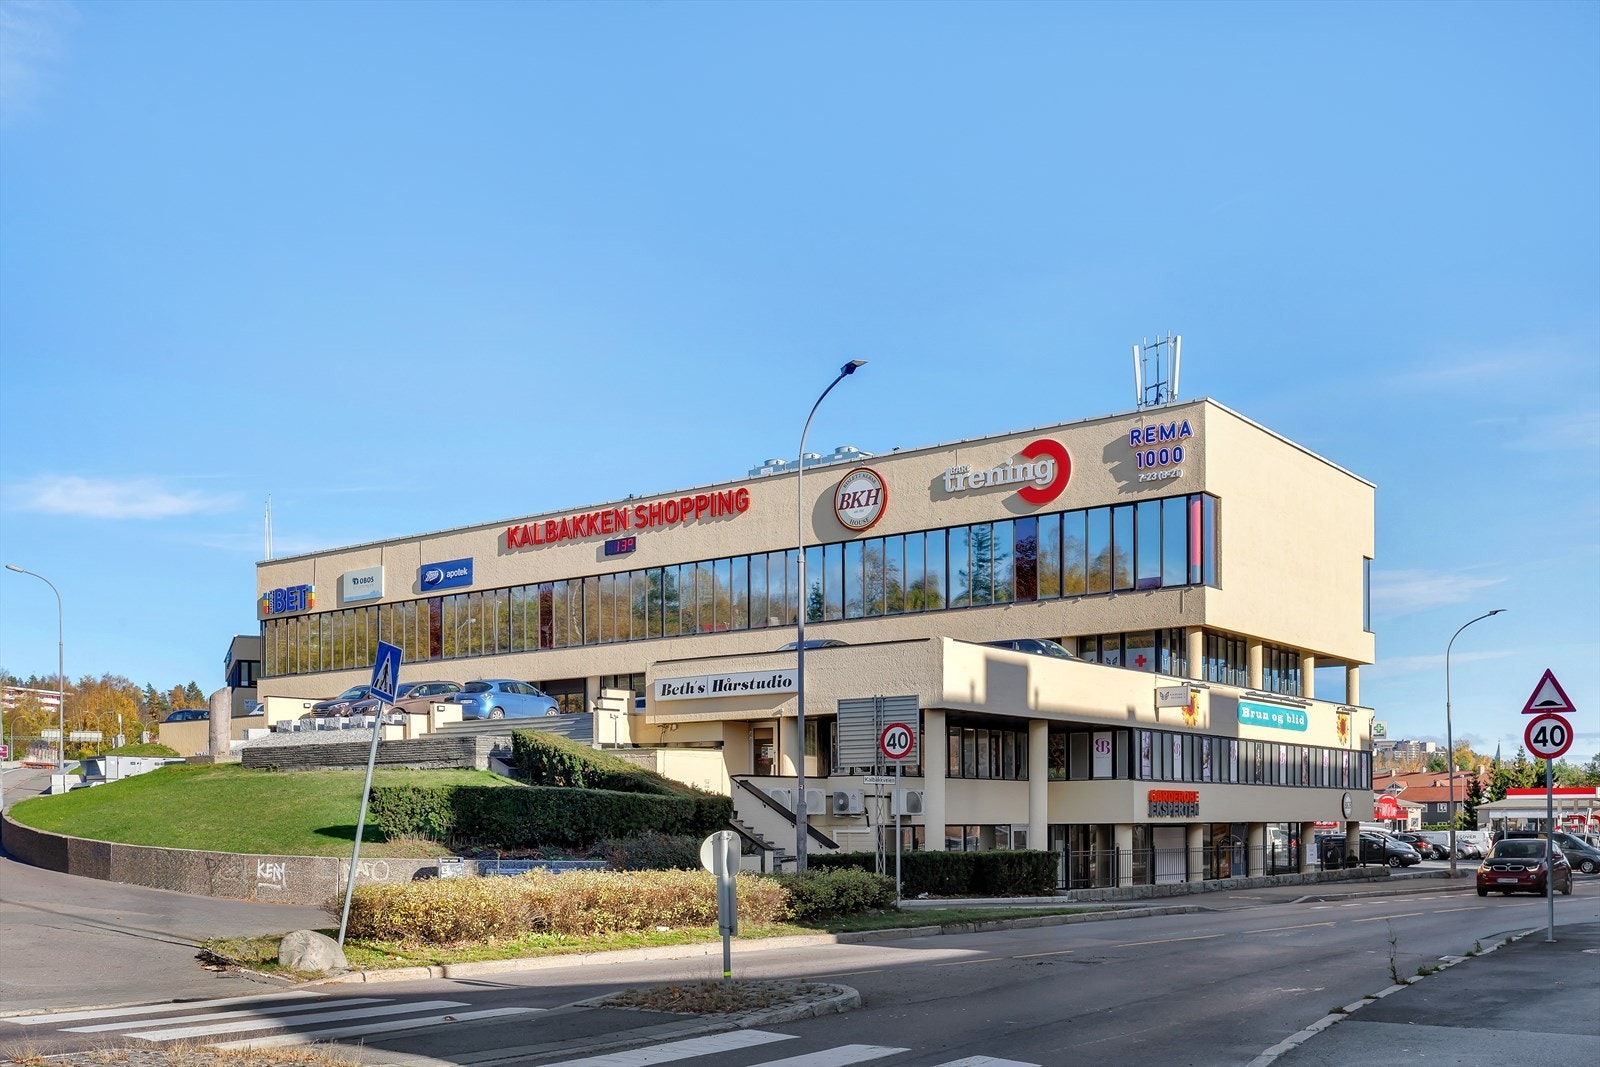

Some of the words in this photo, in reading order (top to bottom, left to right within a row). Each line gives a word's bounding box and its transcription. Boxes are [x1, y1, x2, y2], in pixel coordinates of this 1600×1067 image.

[1129, 419, 1194, 446] REMA
[1136, 446, 1185, 470] 1000
[943, 458, 1054, 493] trening
[838, 488, 882, 510] BKH
[507, 507, 629, 549] KALBAKKEN
[634, 488, 750, 529] SHOPPING
[360, 576, 374, 584] OBOS
[446, 567, 468, 578] apotek
[274, 584, 307, 614] BET
[712, 674, 792, 693] Hårstudio
[1241, 706, 1269, 720] Brun
[1272, 713, 1284, 724] og
[1286, 713, 1305, 725] blid
[887, 732, 908, 750] 40
[1533, 725, 1566, 747] 40
[1149, 803, 1200, 817] EKSPERTEN
